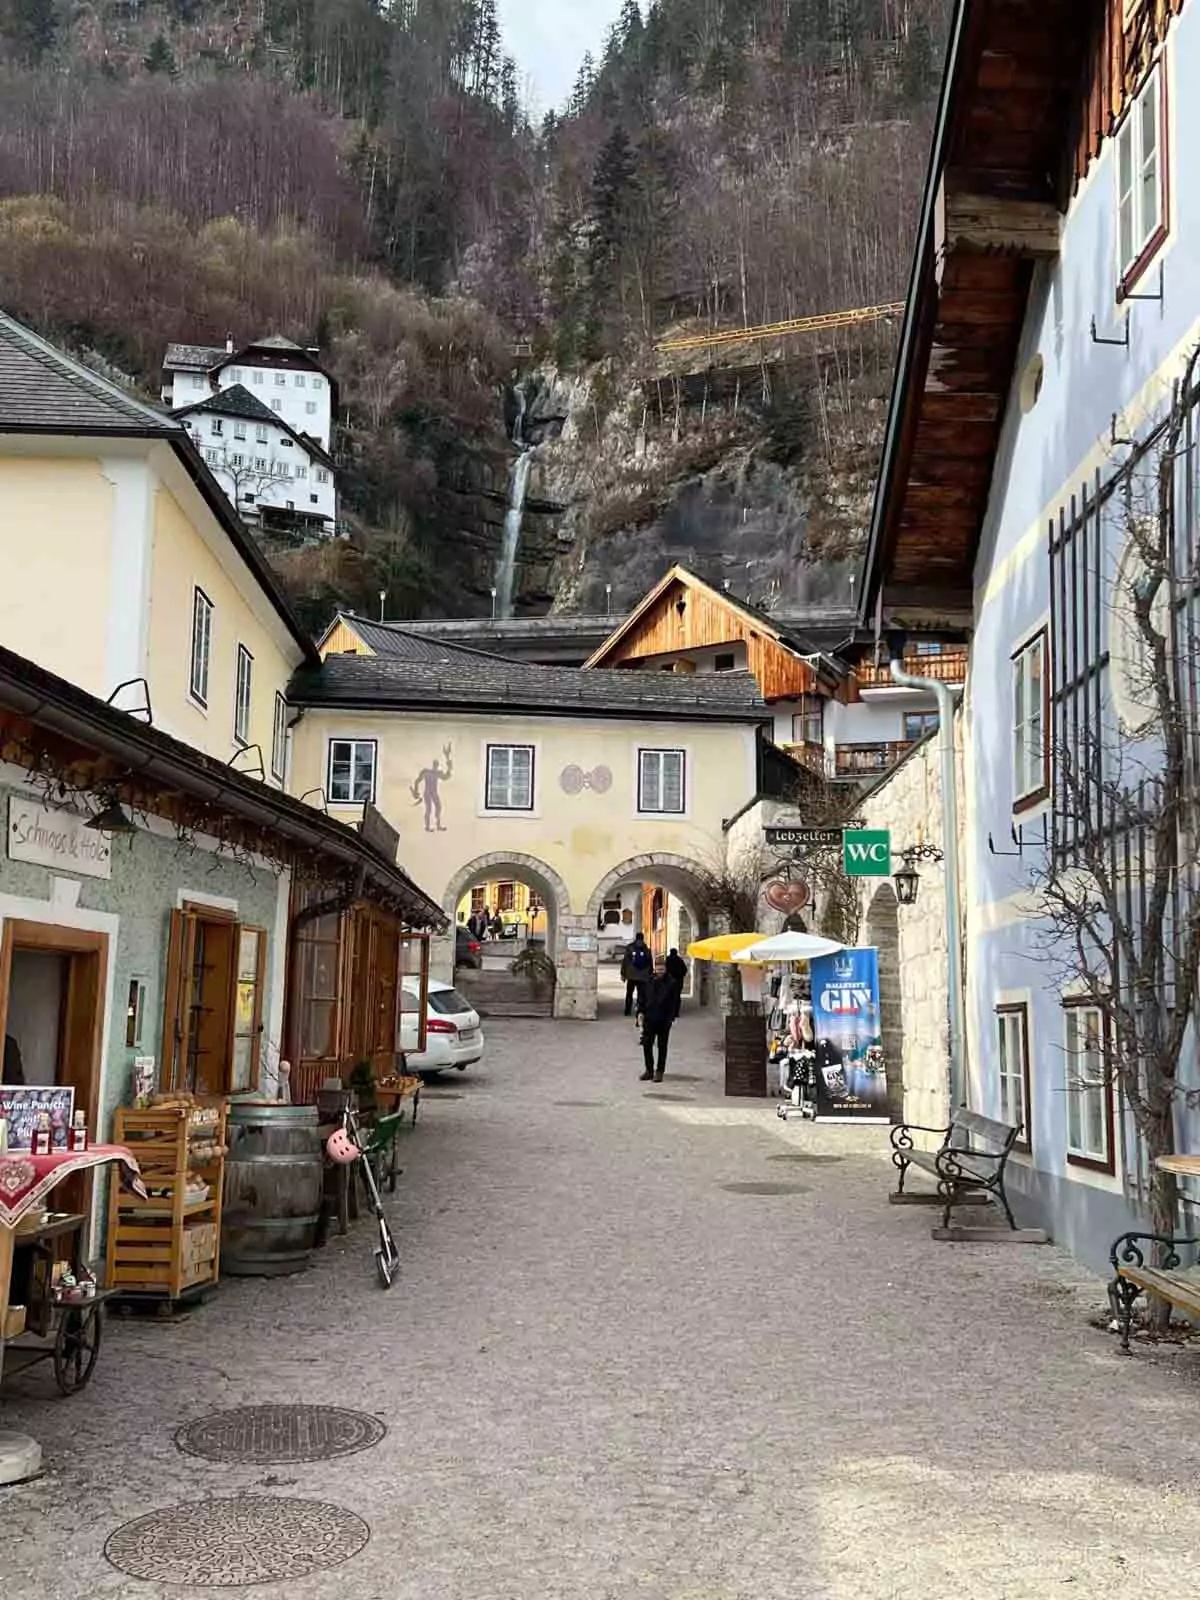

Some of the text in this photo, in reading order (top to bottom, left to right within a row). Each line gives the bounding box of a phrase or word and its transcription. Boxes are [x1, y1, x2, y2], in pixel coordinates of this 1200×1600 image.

[15, 811, 66, 857] Schnaps
[80, 832, 105, 861] Holz
[847, 843, 887, 862] WC
[820, 989, 872, 1013] GIN
[3, 1100, 29, 1110] Wine
